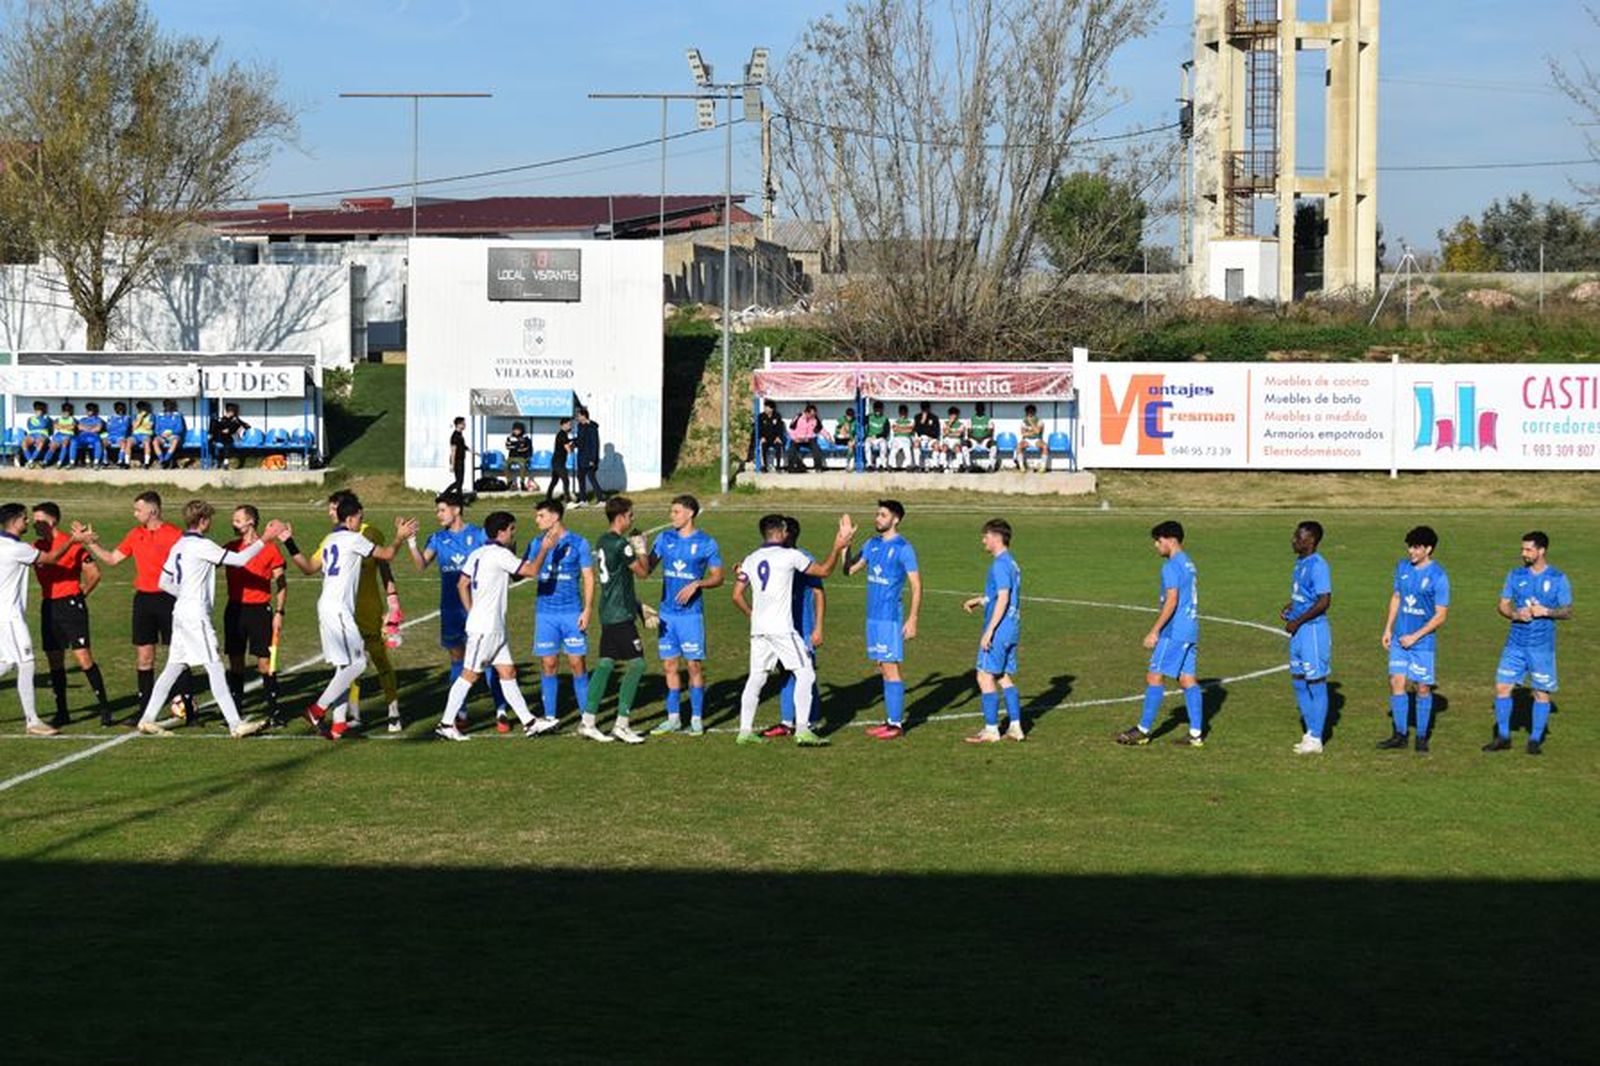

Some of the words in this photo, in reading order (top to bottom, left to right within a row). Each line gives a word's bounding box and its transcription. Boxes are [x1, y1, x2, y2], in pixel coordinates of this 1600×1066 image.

[497, 268, 526, 281] LOCAL
[532, 268, 579, 282] VISITANTES
[495, 367, 575, 379] VILLARALBO
[884, 374, 935, 392] Casa
[1264, 375, 1311, 386] Muebles
[1315, 375, 1329, 386] de
[1333, 375, 1370, 386] cocina
[1264, 393, 1311, 404] Muebles
[1315, 393, 1329, 404] de
[1332, 392, 1361, 404] baño
[1522, 376, 1598, 409] CASTI
[472, 395, 514, 406] METAL
[1264, 410, 1311, 421] Muebles
[1314, 413, 1322, 421] a
[1325, 410, 1367, 421] medida
[1263, 428, 1314, 439] Armarios
[1318, 428, 1384, 441] empotrados
[1263, 445, 1361, 456] Electrodomésticos
[1533, 444, 1552, 457] 983
[1556, 444, 1574, 457] 309
[1577, 444, 1596, 457] 807
[757, 559, 771, 592] 9
